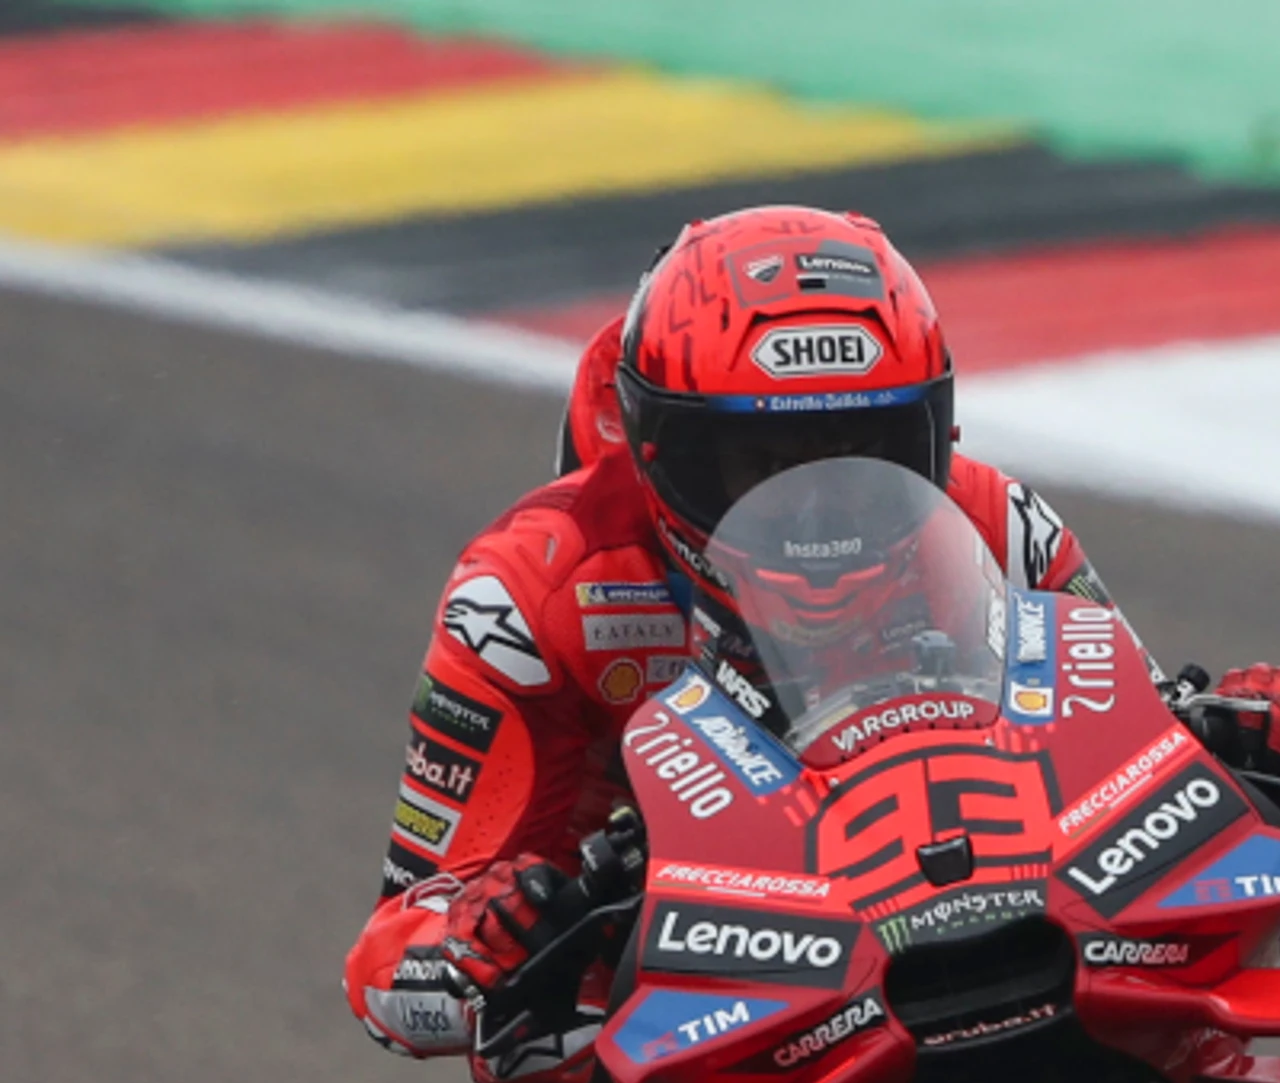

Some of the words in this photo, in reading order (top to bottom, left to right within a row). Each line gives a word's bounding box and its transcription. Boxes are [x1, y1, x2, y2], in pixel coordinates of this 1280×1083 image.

[799, 254, 872, 275] Lenovo
[772, 334, 866, 367] SHOEI
[784, 537, 862, 559] Insta360
[1058, 731, 1187, 834] FRECCIAROSSA
[812, 750, 1058, 900] 93
[1067, 778, 1220, 895] Lenovo
[655, 864, 832, 898] FRECCIAROSSA
[910, 889, 1045, 930] MONSTER
[657, 911, 843, 967] Lenovo
[677, 1001, 751, 1043] TIM
[773, 997, 884, 1067] CARRERA
